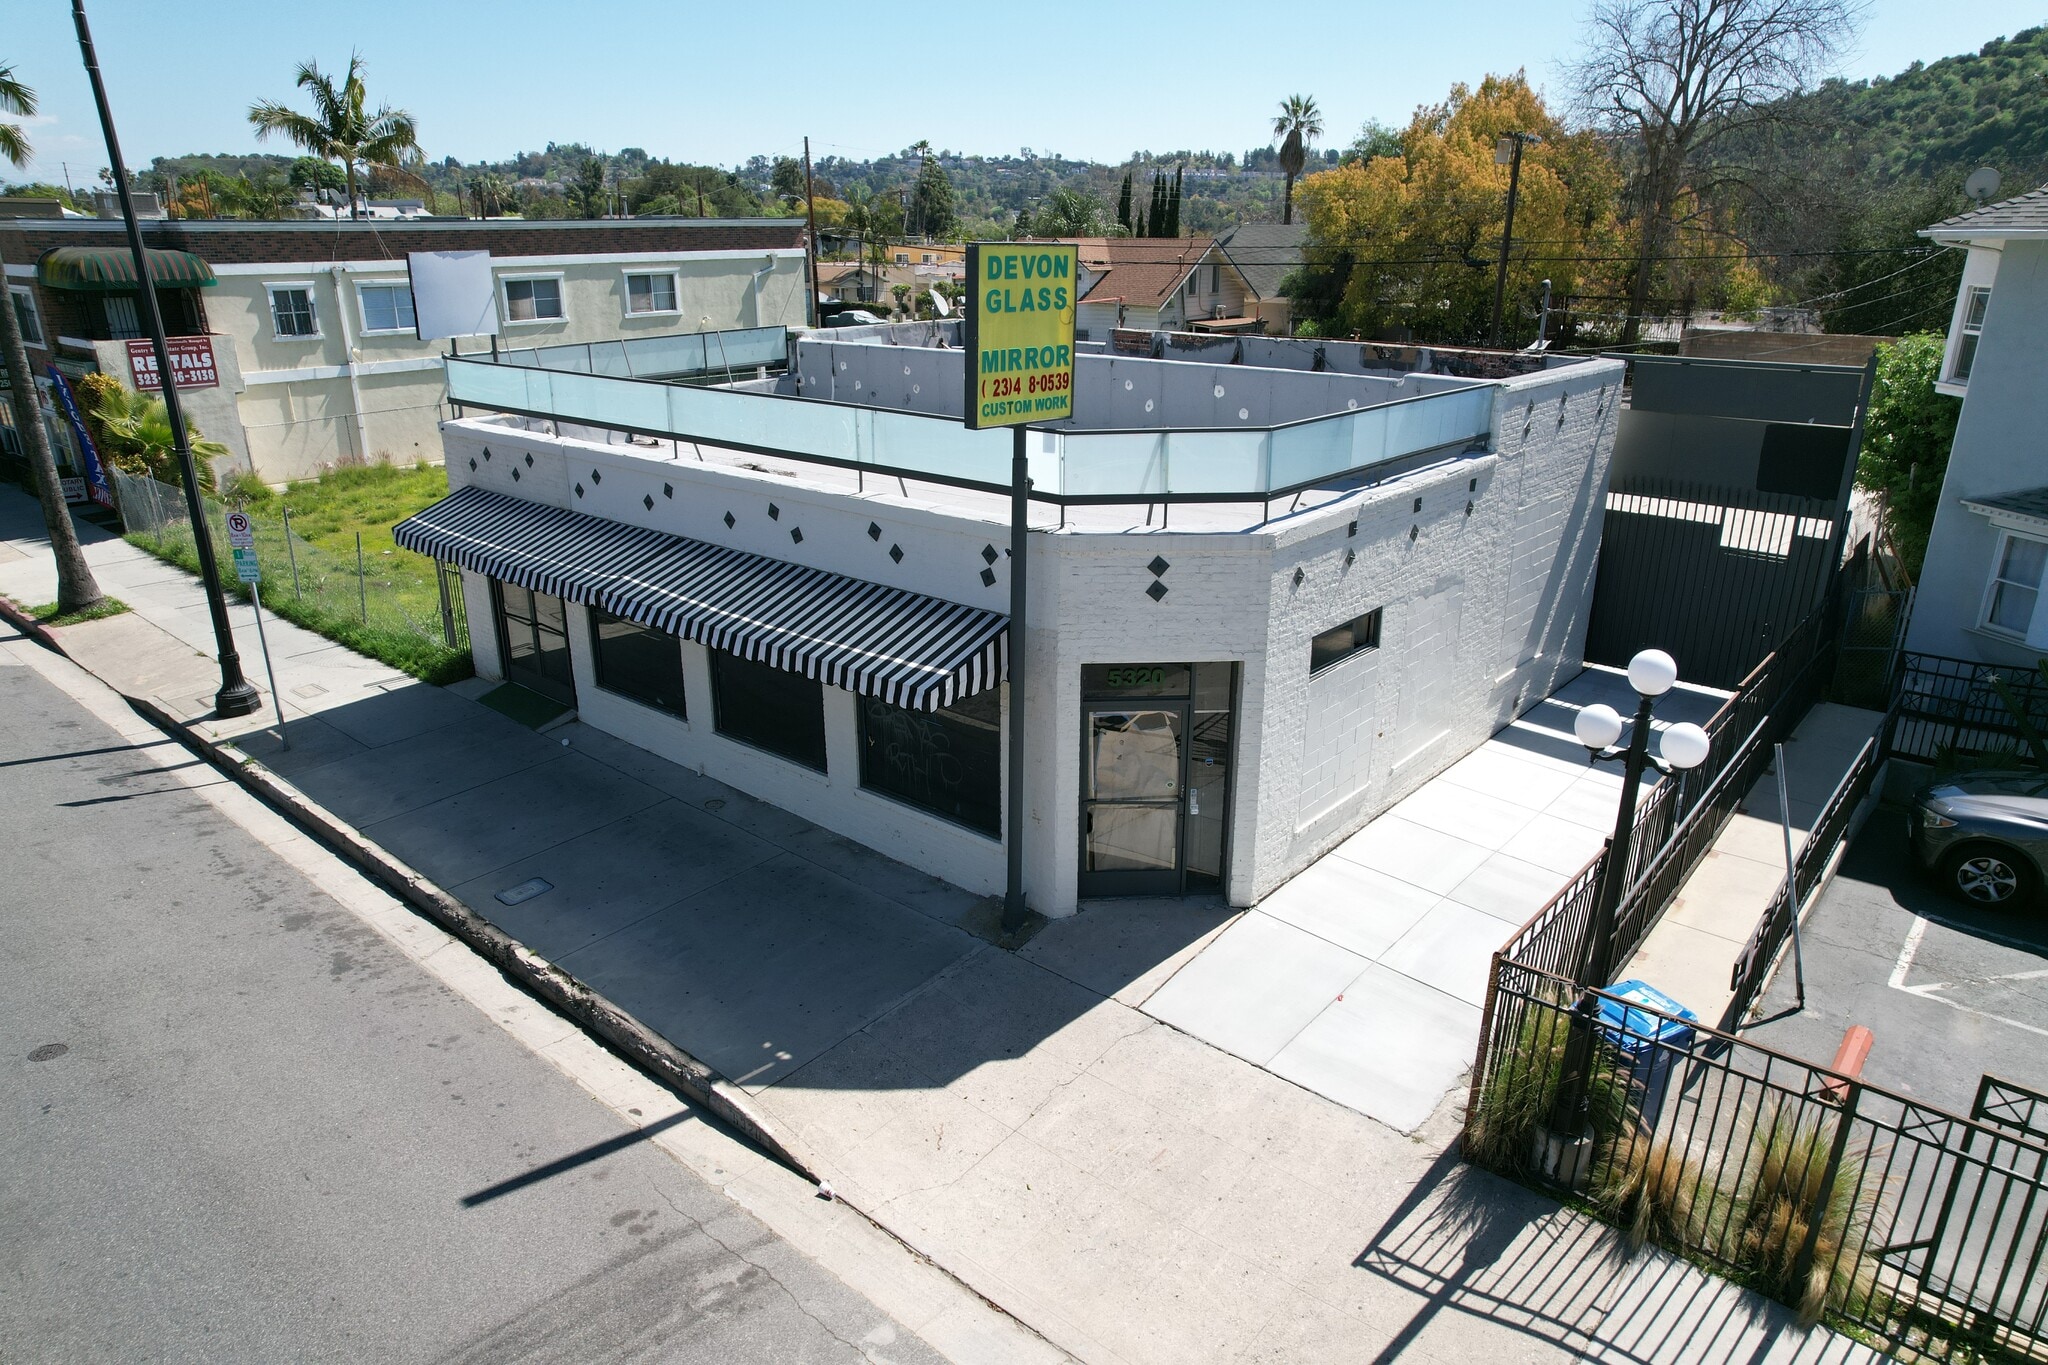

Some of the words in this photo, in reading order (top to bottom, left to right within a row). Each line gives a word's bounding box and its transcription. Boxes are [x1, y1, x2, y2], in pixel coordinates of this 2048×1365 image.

[987, 254, 1069, 280] DEVON
[985, 286, 1068, 314] GLASS
[132, 352, 213, 372] RETALS
[981, 344, 1070, 374] MIRROR
[981, 400, 1032, 417] CUSTOM
[1034, 395, 1068, 412] WORK
[62, 478, 83, 486] OTARY
[63, 485, 85, 493] UBLIC
[1107, 666, 1167, 688] 5320
